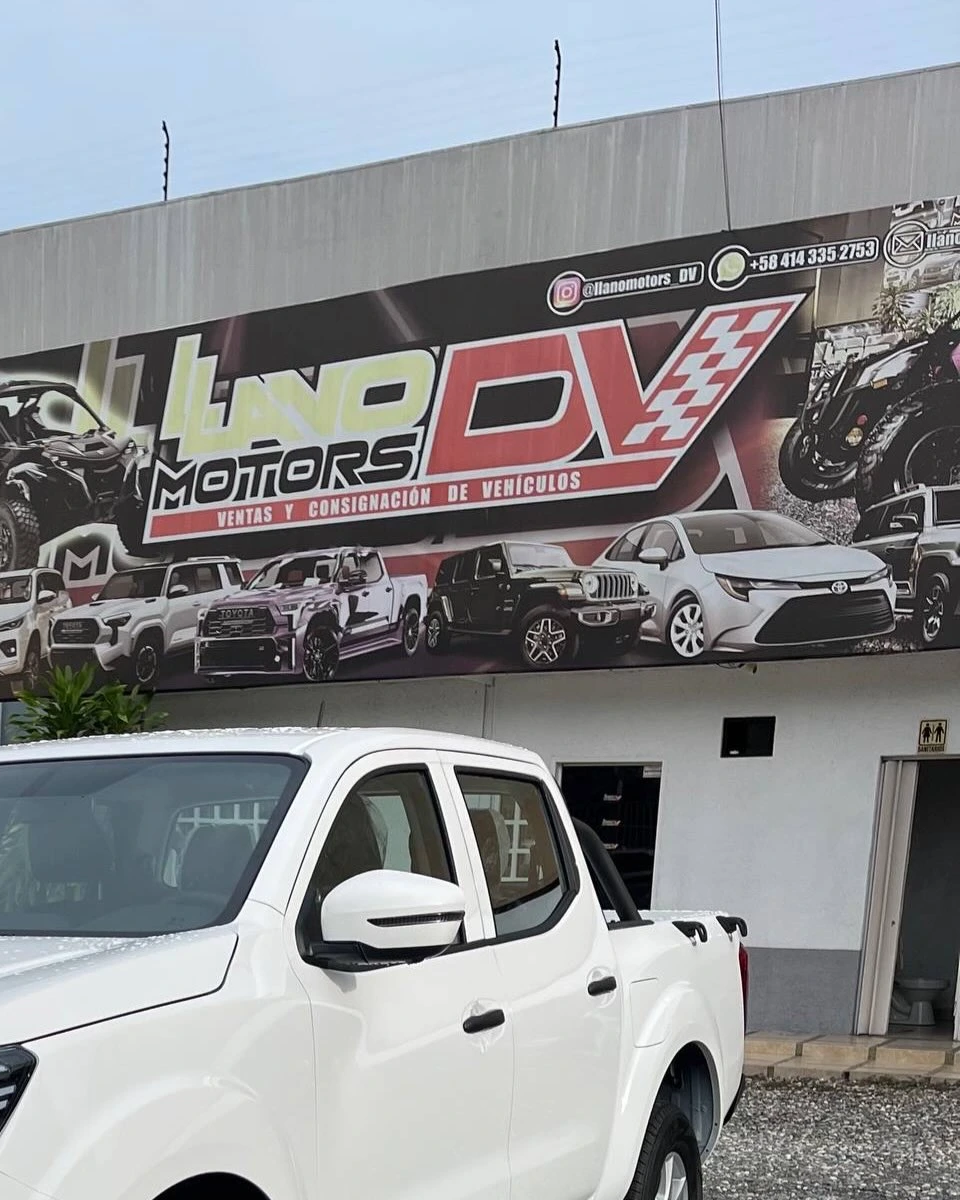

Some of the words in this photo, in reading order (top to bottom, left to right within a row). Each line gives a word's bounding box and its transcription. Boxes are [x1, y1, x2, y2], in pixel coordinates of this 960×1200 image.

[750, 254, 778, 272] +58
[780, 250, 805, 268] 414
[808, 247, 836, 265] 335
[839, 241, 875, 260] 2753
[427, 293, 807, 476] DV
[152, 432, 422, 510] MOTORS
[217, 507, 273, 528] VENTAS
[285, 504, 295, 520] Y
[309, 486, 431, 518] CONSIGNACIÓN
[448, 483, 468, 503] DE
[482, 471, 581, 500] VEHÍCULOS
[221, 608, 255, 619] TOYOTA
